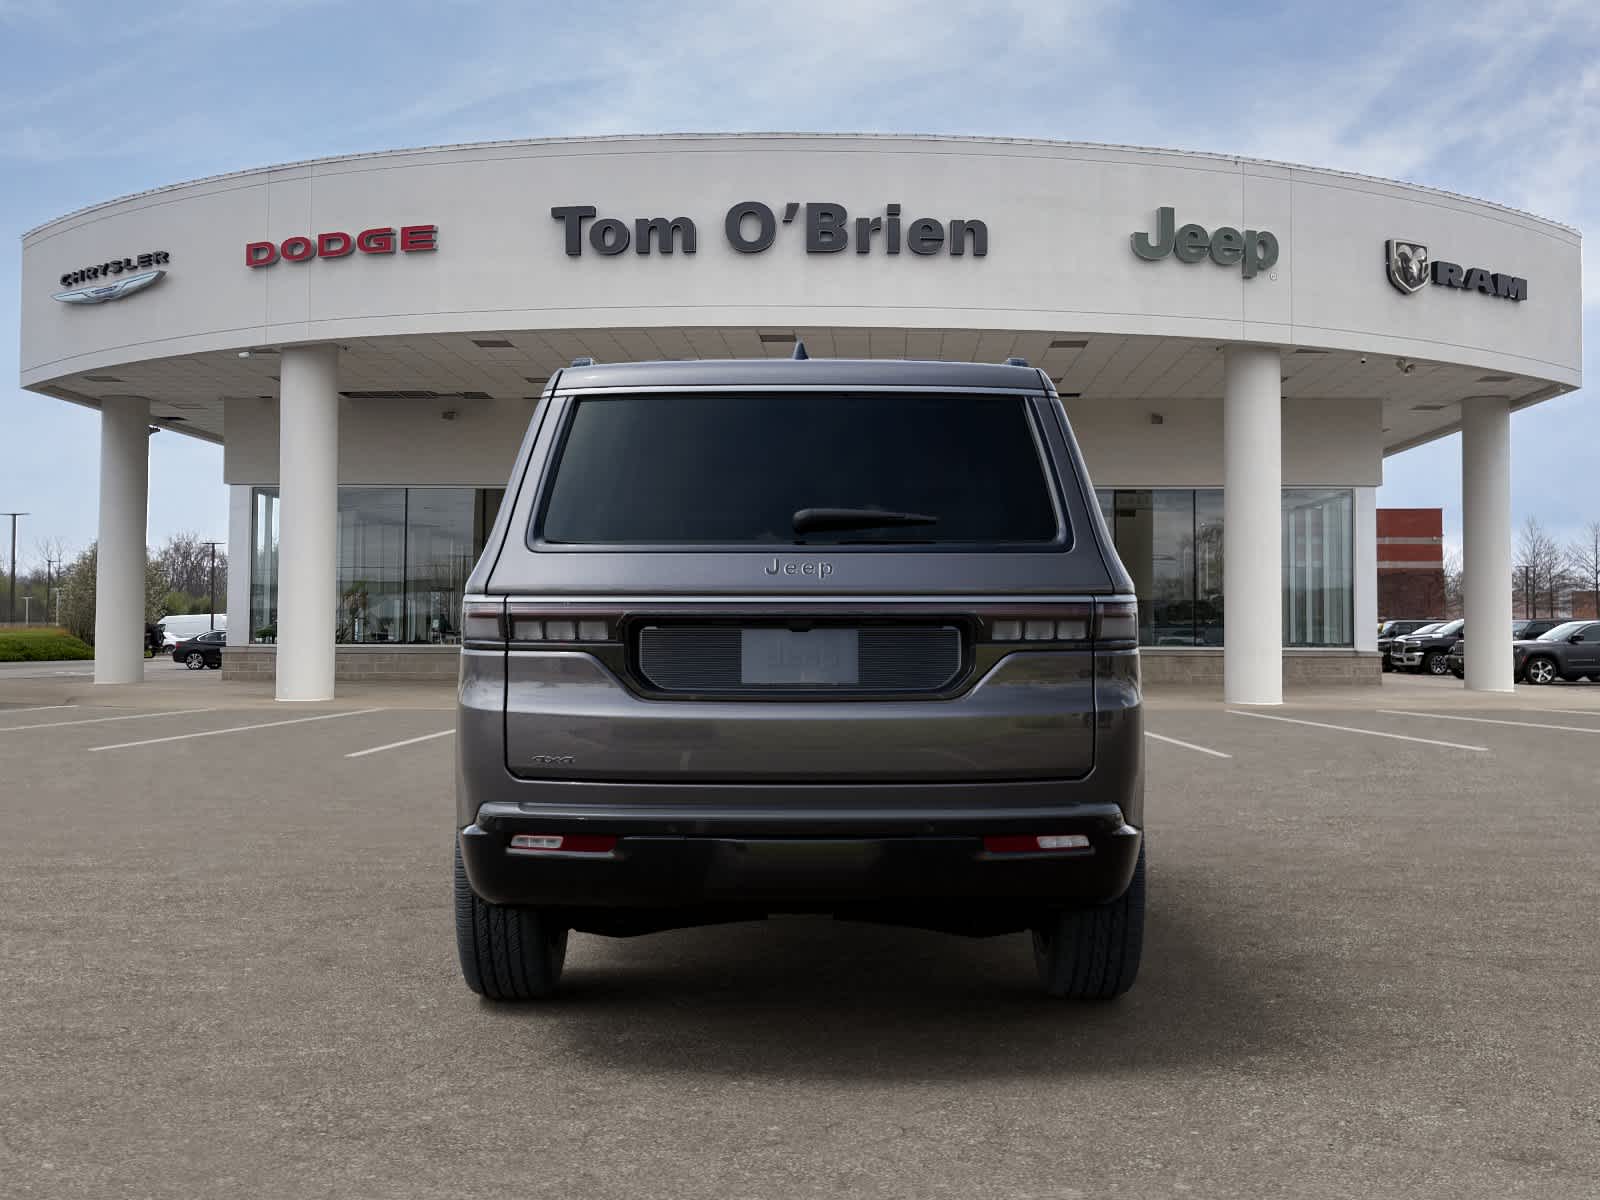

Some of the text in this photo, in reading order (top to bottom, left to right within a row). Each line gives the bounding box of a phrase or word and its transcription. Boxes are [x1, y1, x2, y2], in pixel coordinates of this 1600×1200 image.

[245, 225, 438, 268] DODGE
[551, 205, 697, 256] Tom
[1130, 206, 1279, 279] Jeep
[60, 250, 170, 286] CHRYSLER
[1431, 260, 1527, 300] RAM
[764, 558, 833, 580] Jeep
